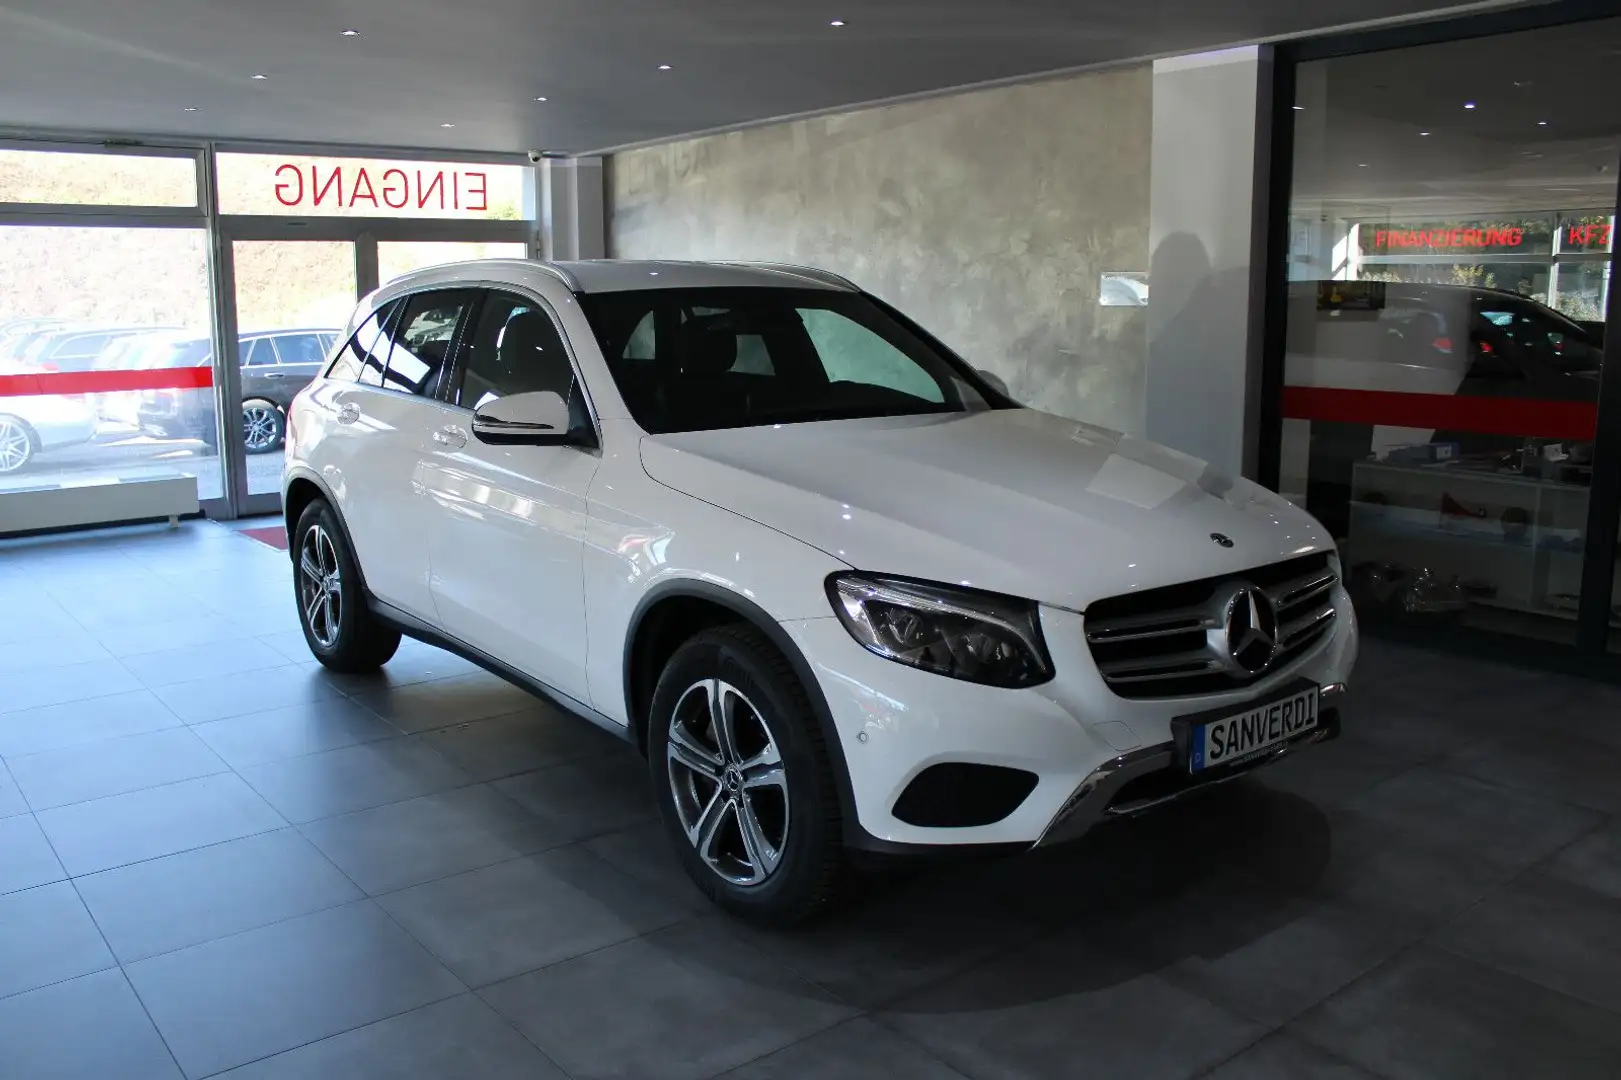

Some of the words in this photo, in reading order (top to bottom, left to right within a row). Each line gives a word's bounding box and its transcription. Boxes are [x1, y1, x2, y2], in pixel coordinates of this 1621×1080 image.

[1375, 226, 1522, 248] FINANZIERUNG
[1568, 224, 1612, 245] KFZ
[1194, 752, 1202, 764] D
[1210, 692, 1314, 760] SANVERDI
